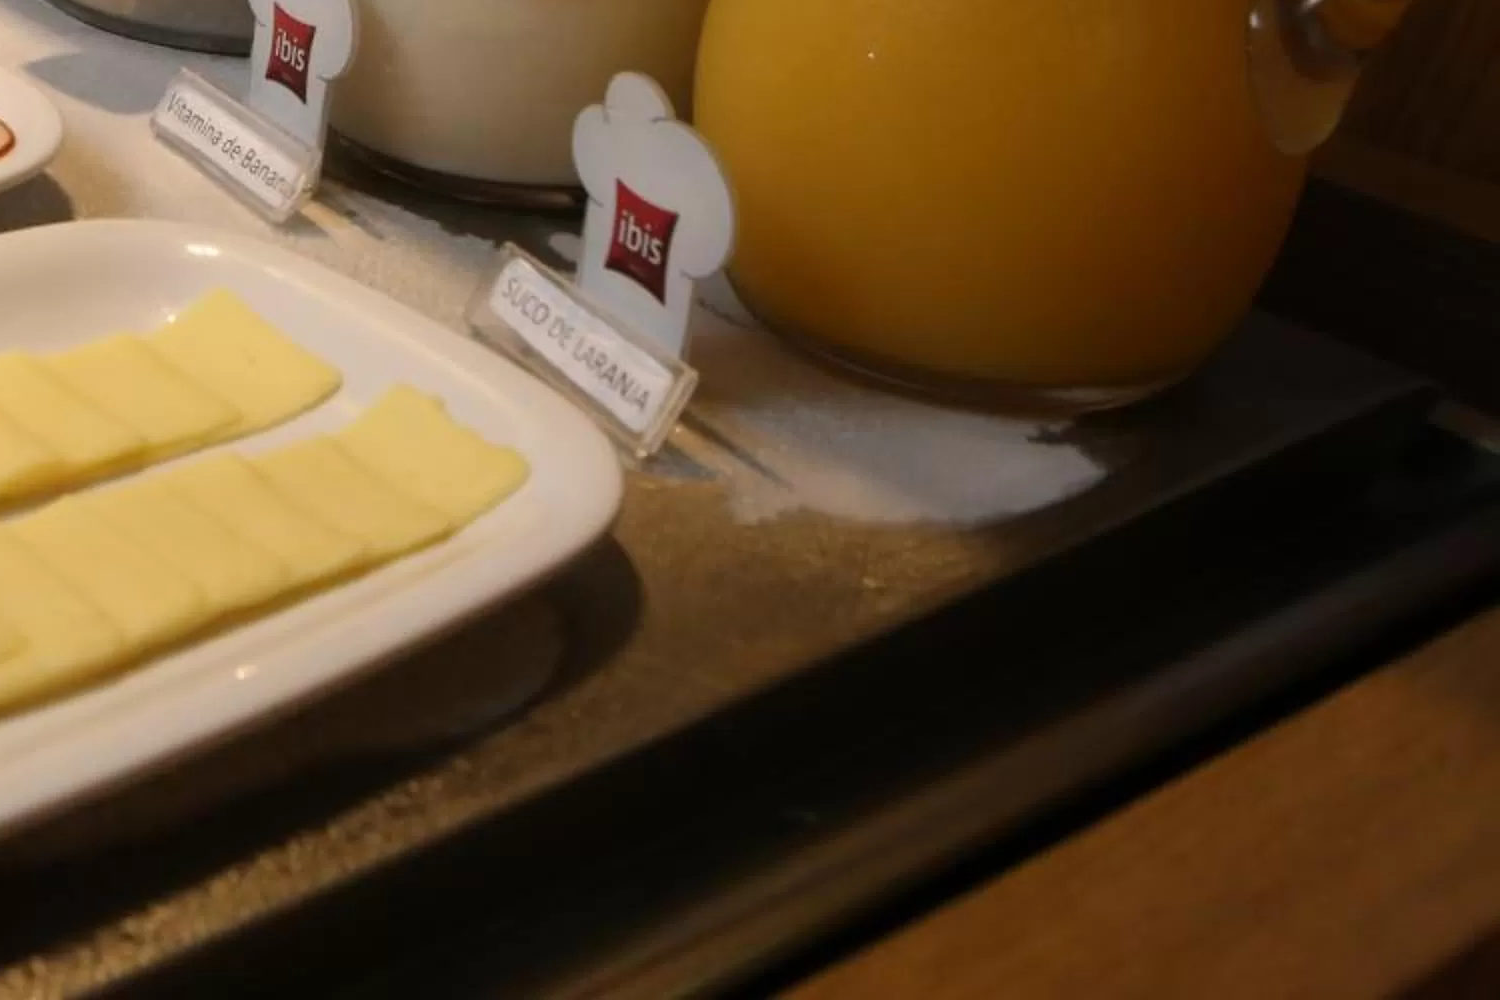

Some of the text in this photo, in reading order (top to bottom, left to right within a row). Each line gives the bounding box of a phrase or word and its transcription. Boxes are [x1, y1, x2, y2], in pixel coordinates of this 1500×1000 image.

[275, 28, 305, 71] ibis
[167, 90, 294, 198] Vitamina de Banan
[619, 209, 662, 264] ibis
[502, 278, 550, 325] SUCO
[548, 316, 575, 350] DE
